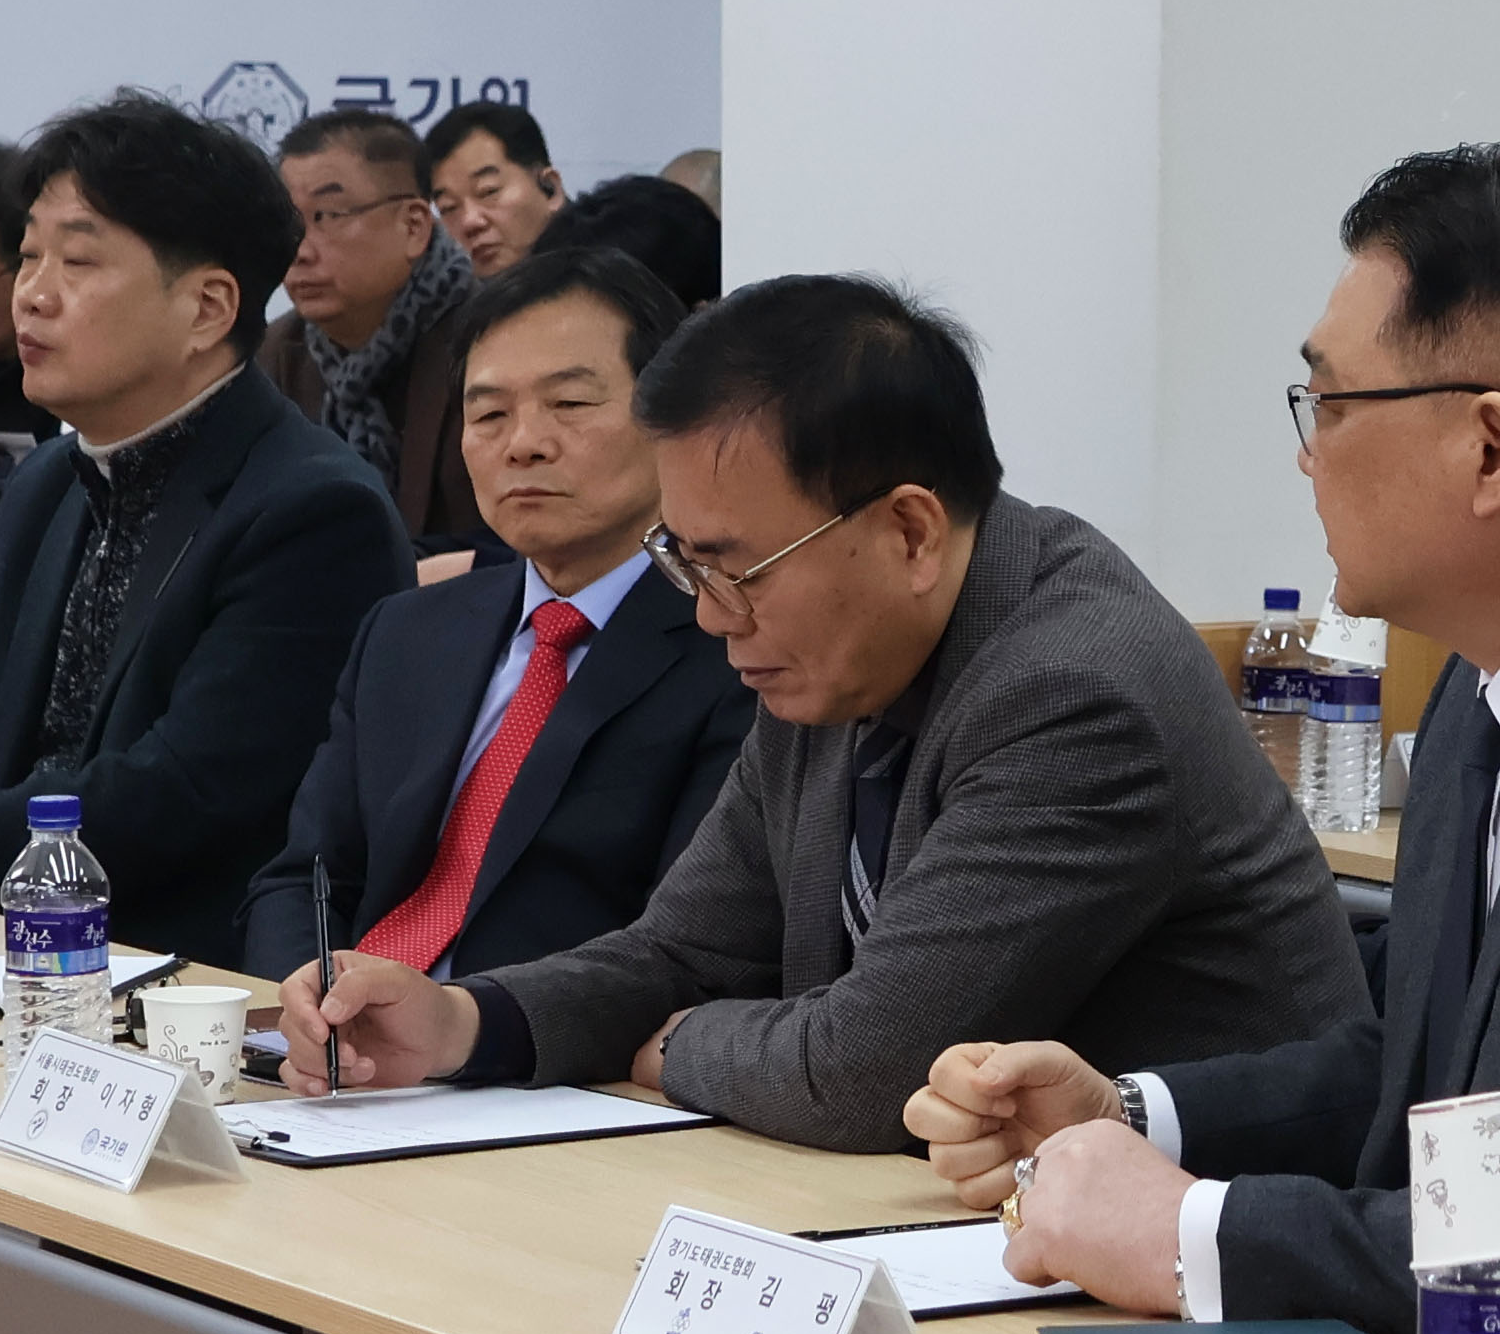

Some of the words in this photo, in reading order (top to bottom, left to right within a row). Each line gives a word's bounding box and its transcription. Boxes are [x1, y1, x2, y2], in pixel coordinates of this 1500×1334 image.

[11, 919, 53, 952] 광천수
[35, 1051, 101, 1085] 서울시태권도협회
[668, 1237, 757, 1281] 경기도태권도협회
